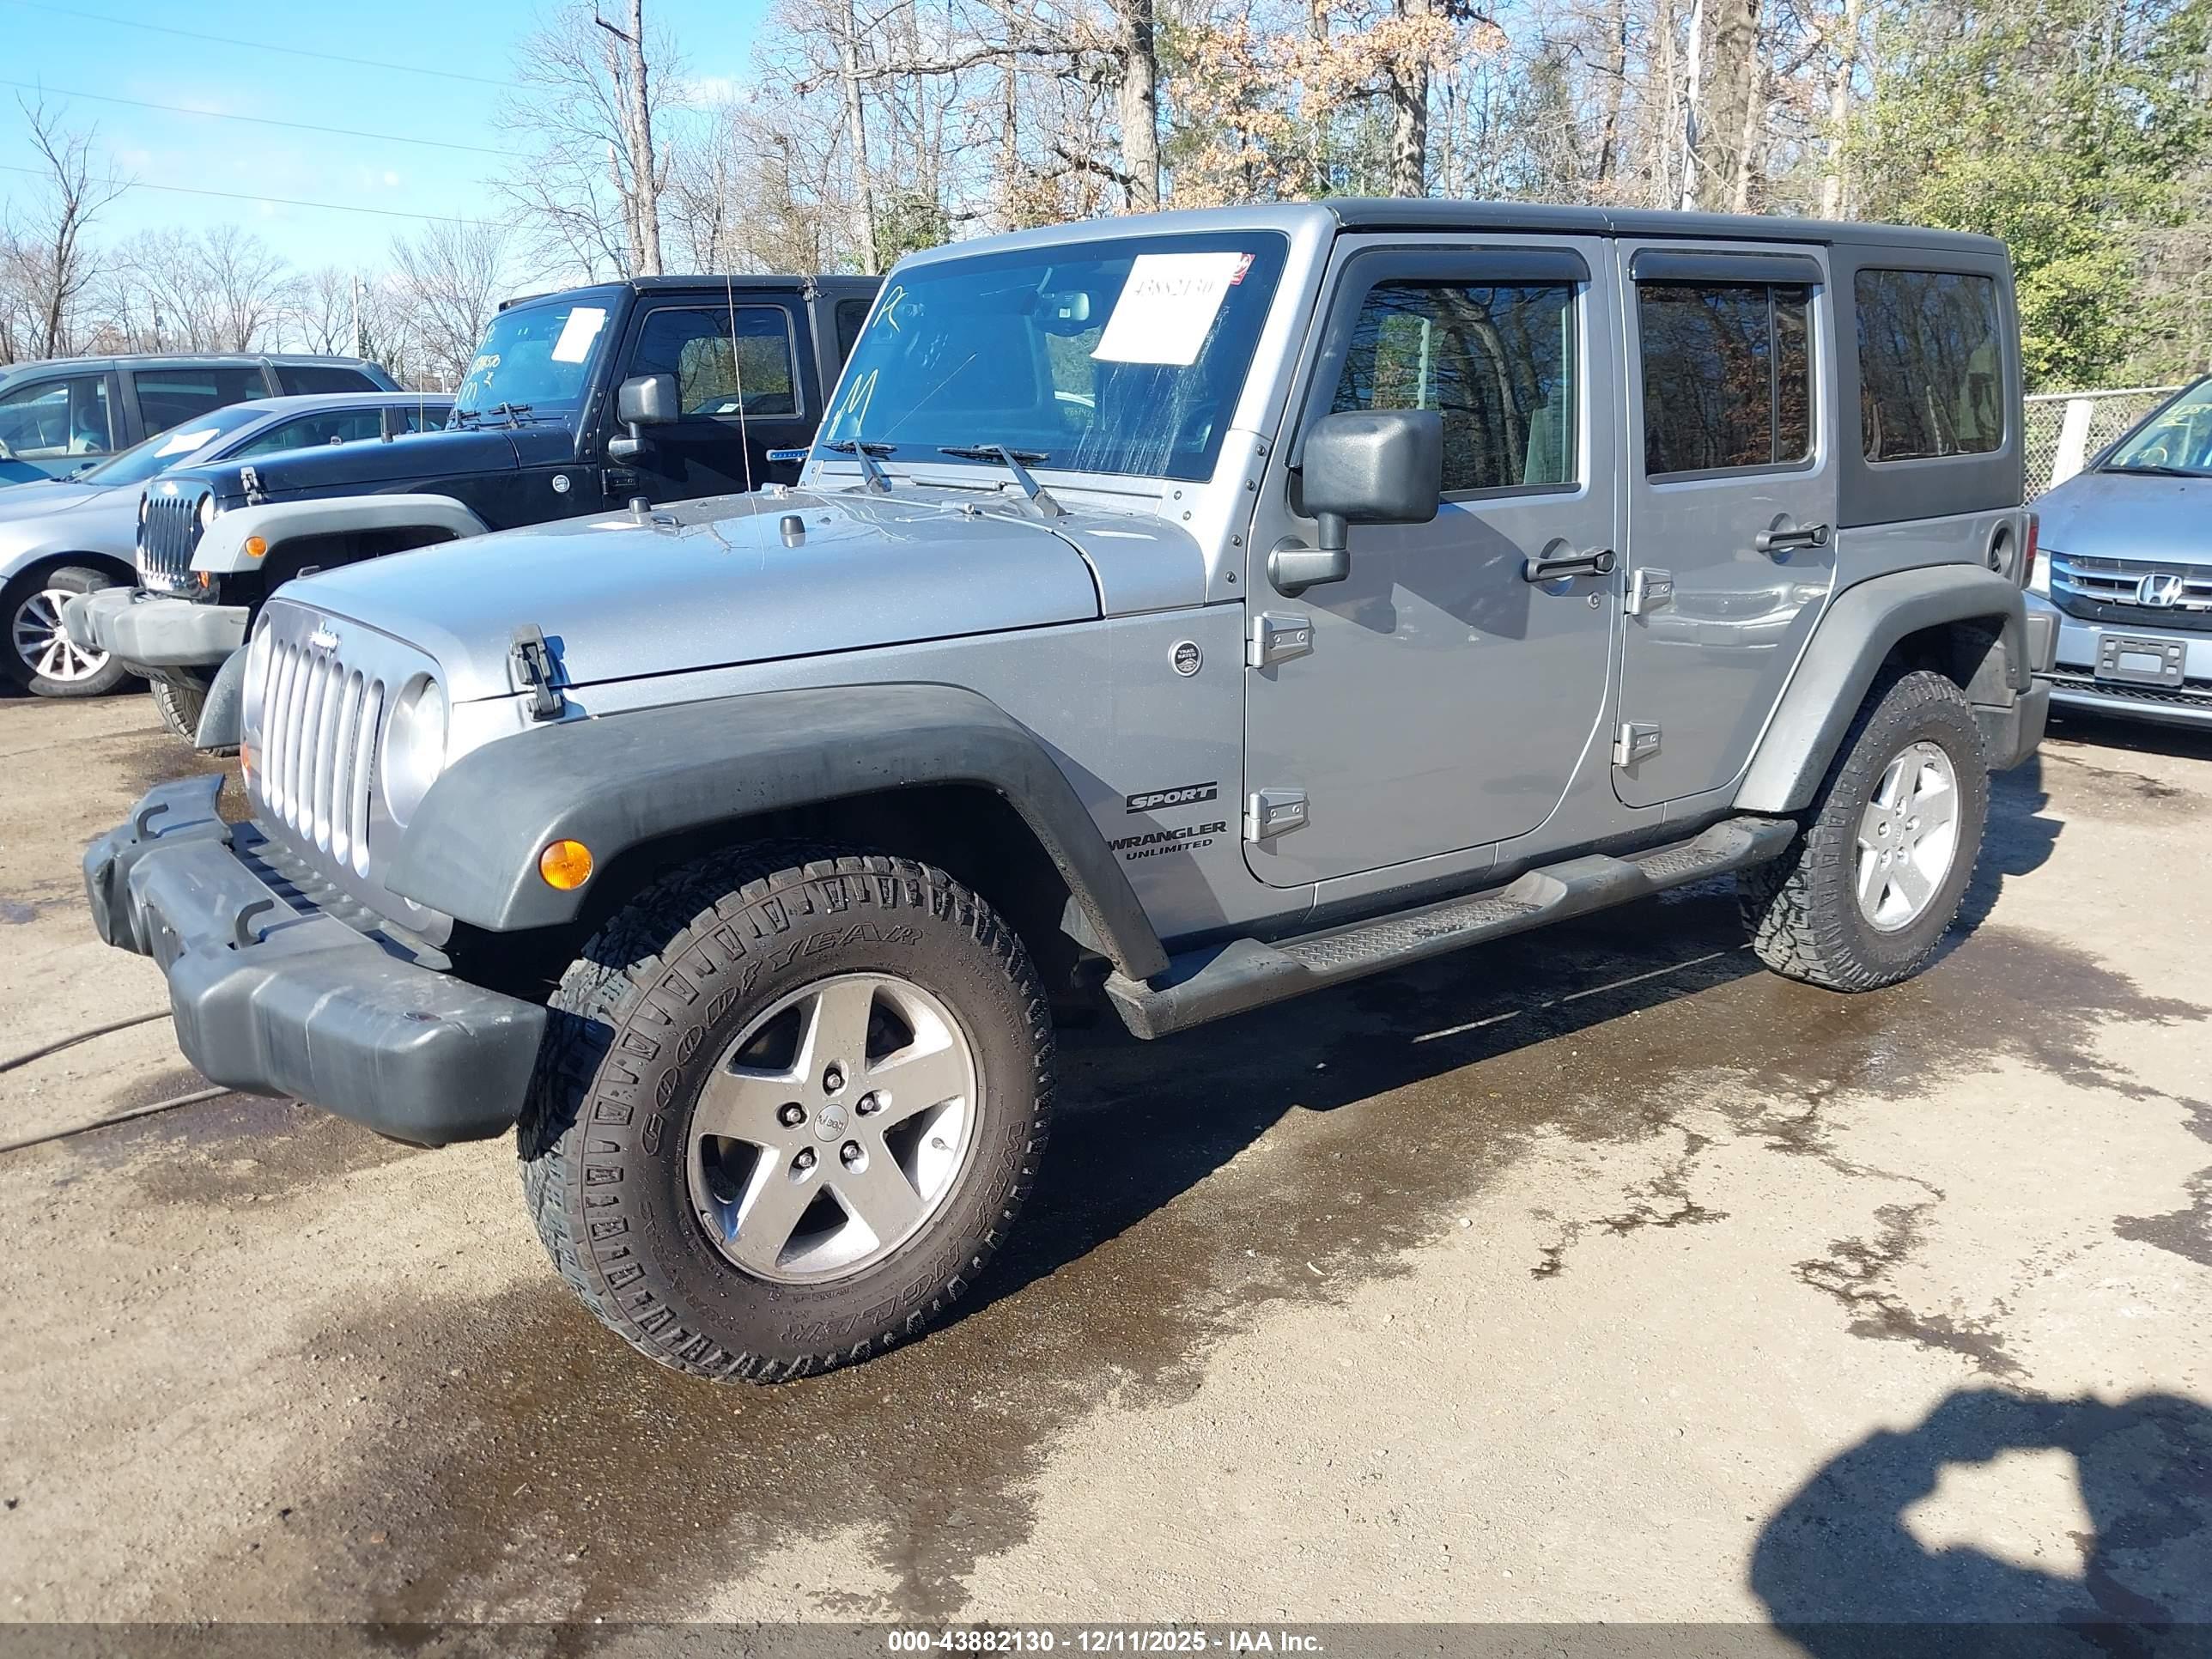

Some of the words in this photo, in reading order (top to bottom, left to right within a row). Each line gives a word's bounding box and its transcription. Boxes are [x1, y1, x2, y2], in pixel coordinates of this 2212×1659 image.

[1131, 785, 1218, 810] SPORT
[1107, 821, 1227, 851] WRANGLER
[1126, 838, 1213, 860] UNLIMITED
[817, 1114, 845, 1132] Jeep
